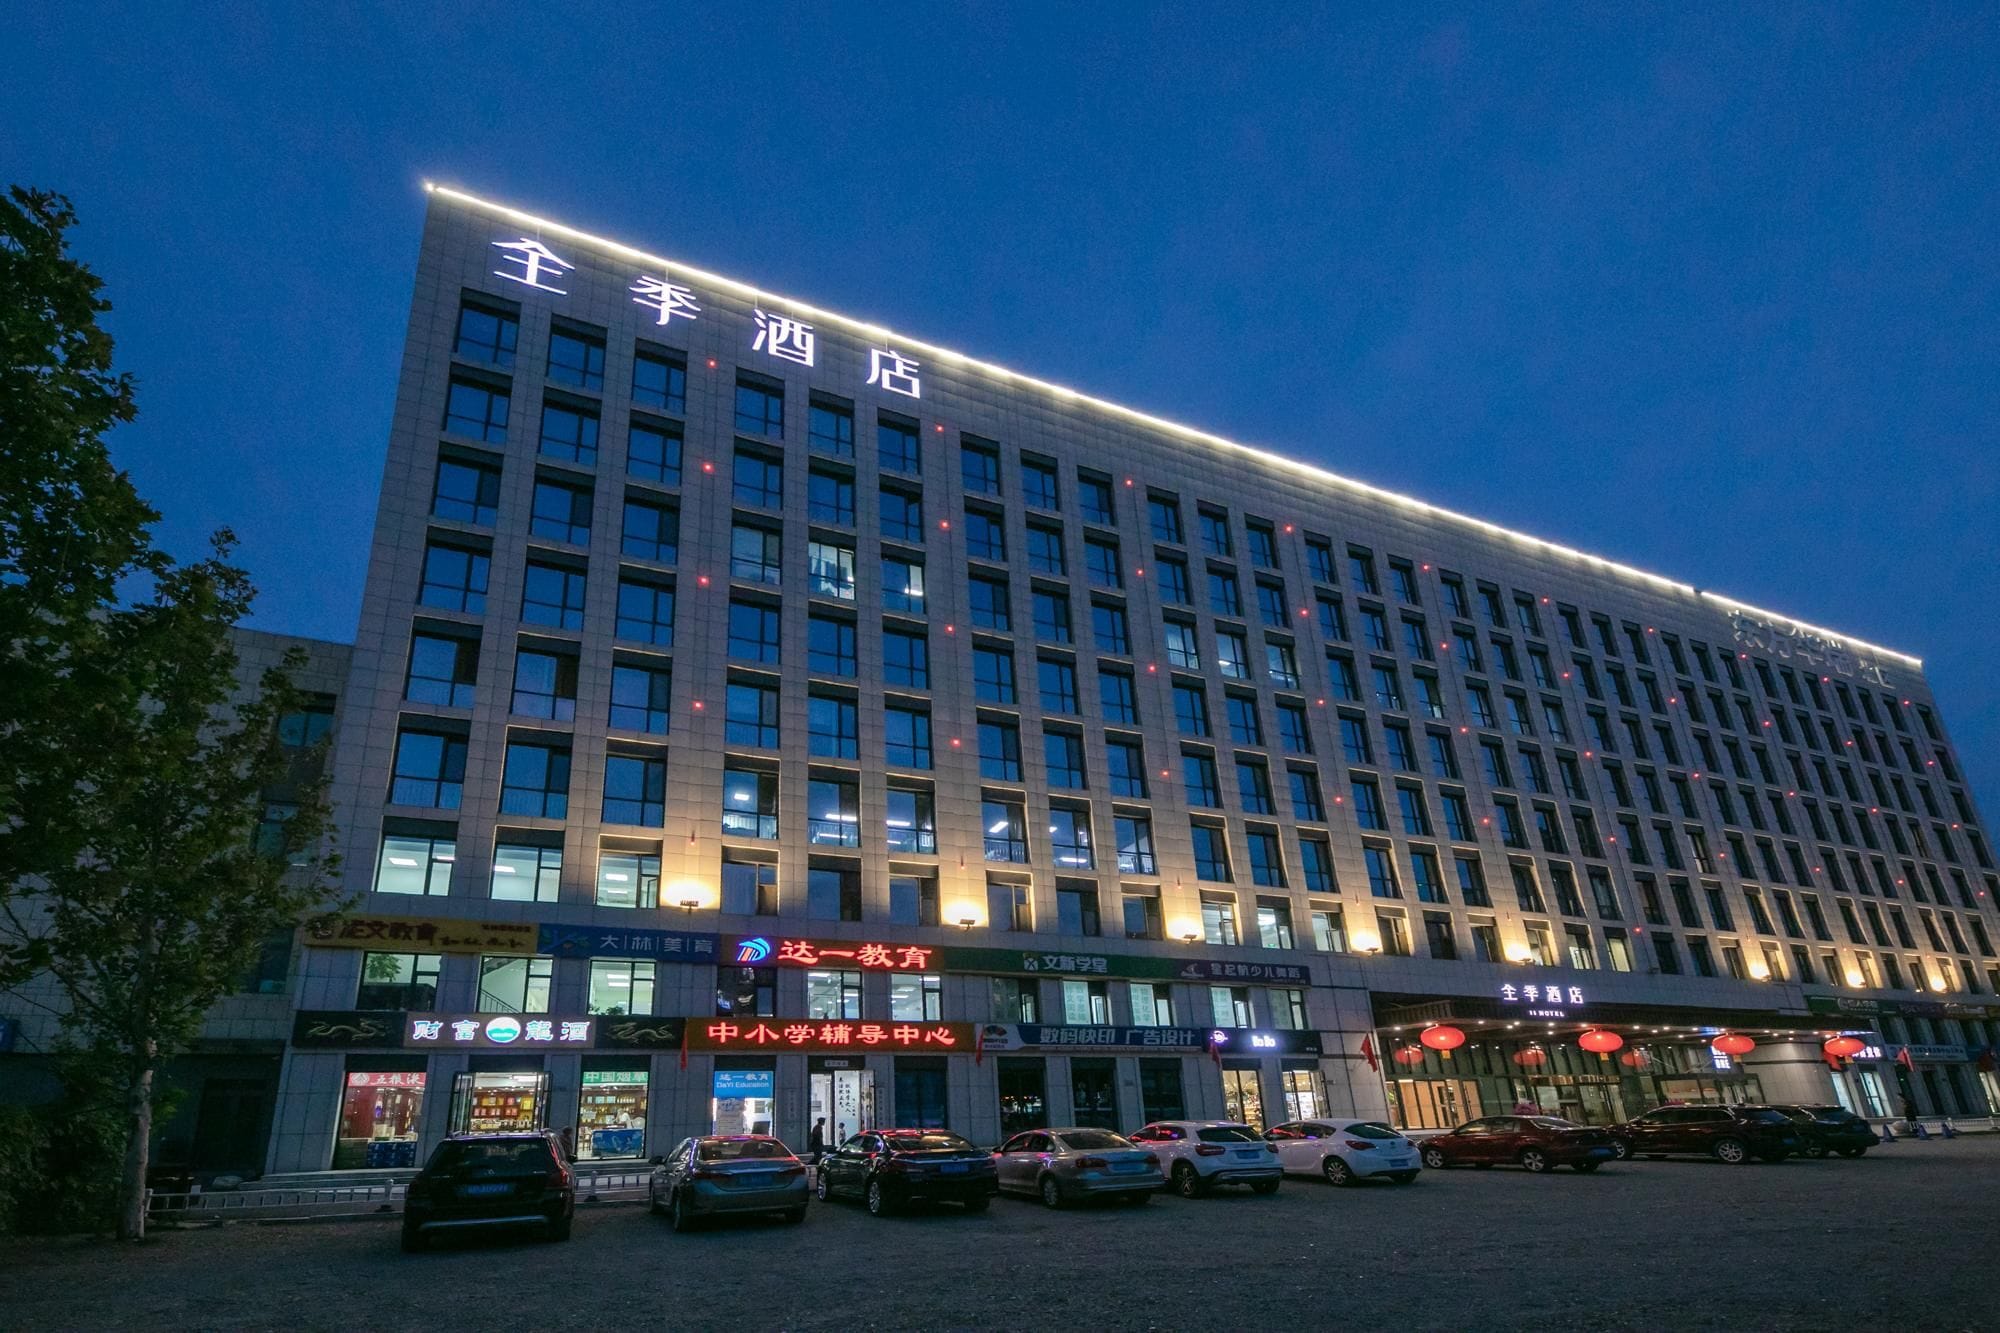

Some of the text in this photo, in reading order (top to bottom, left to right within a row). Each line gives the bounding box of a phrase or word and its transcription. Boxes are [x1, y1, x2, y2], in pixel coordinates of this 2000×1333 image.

[490, 237, 921, 399] 全季酒店
[777, 940, 933, 969] 达一教育
[1500, 984, 1584, 1004] 全季酒店
[707, 1021, 956, 1047] 中小学辅导中心
[1039, 1027, 1196, 1046] 数码快印 广告设计
[718, 1073, 769, 1081] 达一教育
[735, 1081, 770, 1089] Education
